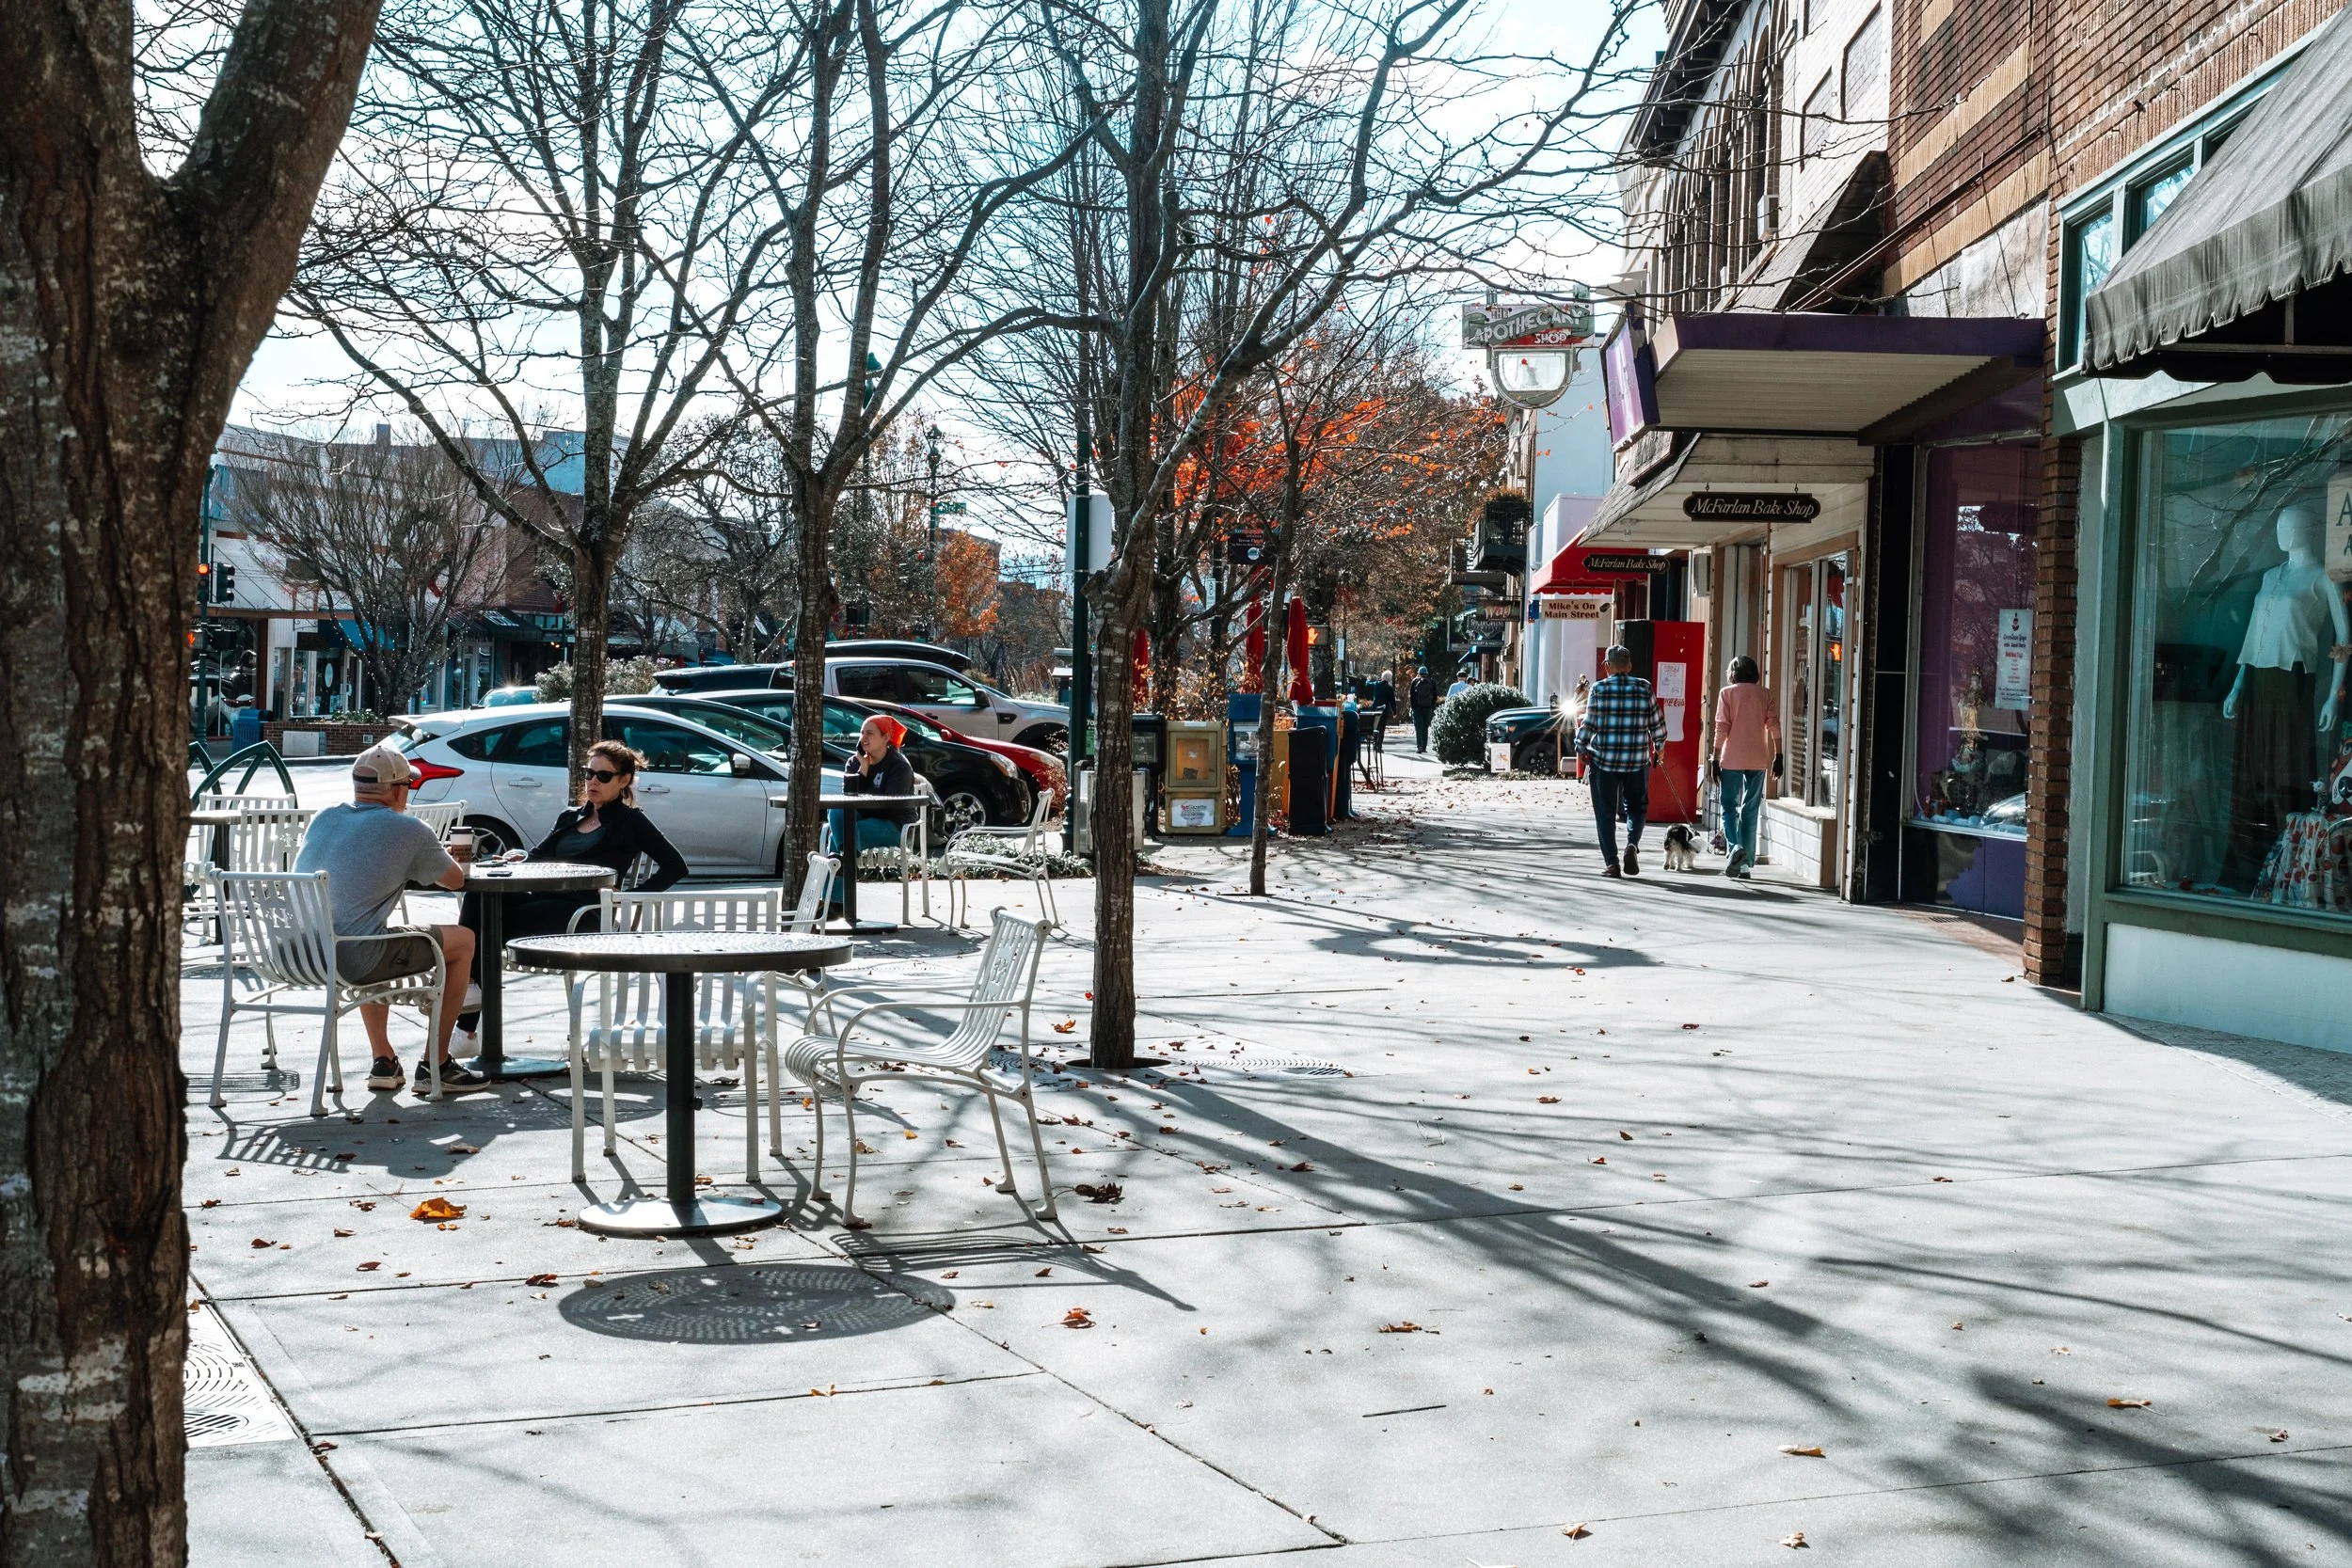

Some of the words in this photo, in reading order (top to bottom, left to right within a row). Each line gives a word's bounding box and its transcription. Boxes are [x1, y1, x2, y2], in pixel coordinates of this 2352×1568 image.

[1491, 308, 1510, 319] THE
[1473, 309, 1582, 342] APOTHECARY
[1534, 332, 1567, 344] SHOP
[1692, 498, 1751, 514] McFarlan
[1751, 499, 1783, 515] Bake
[1784, 500, 1815, 517] Shop
[1588, 558, 1626, 568] McFarlan
[1626, 559, 1645, 569] Bake
[1645, 559, 1666, 571] Shop
[1549, 601, 1580, 610] Mike's
